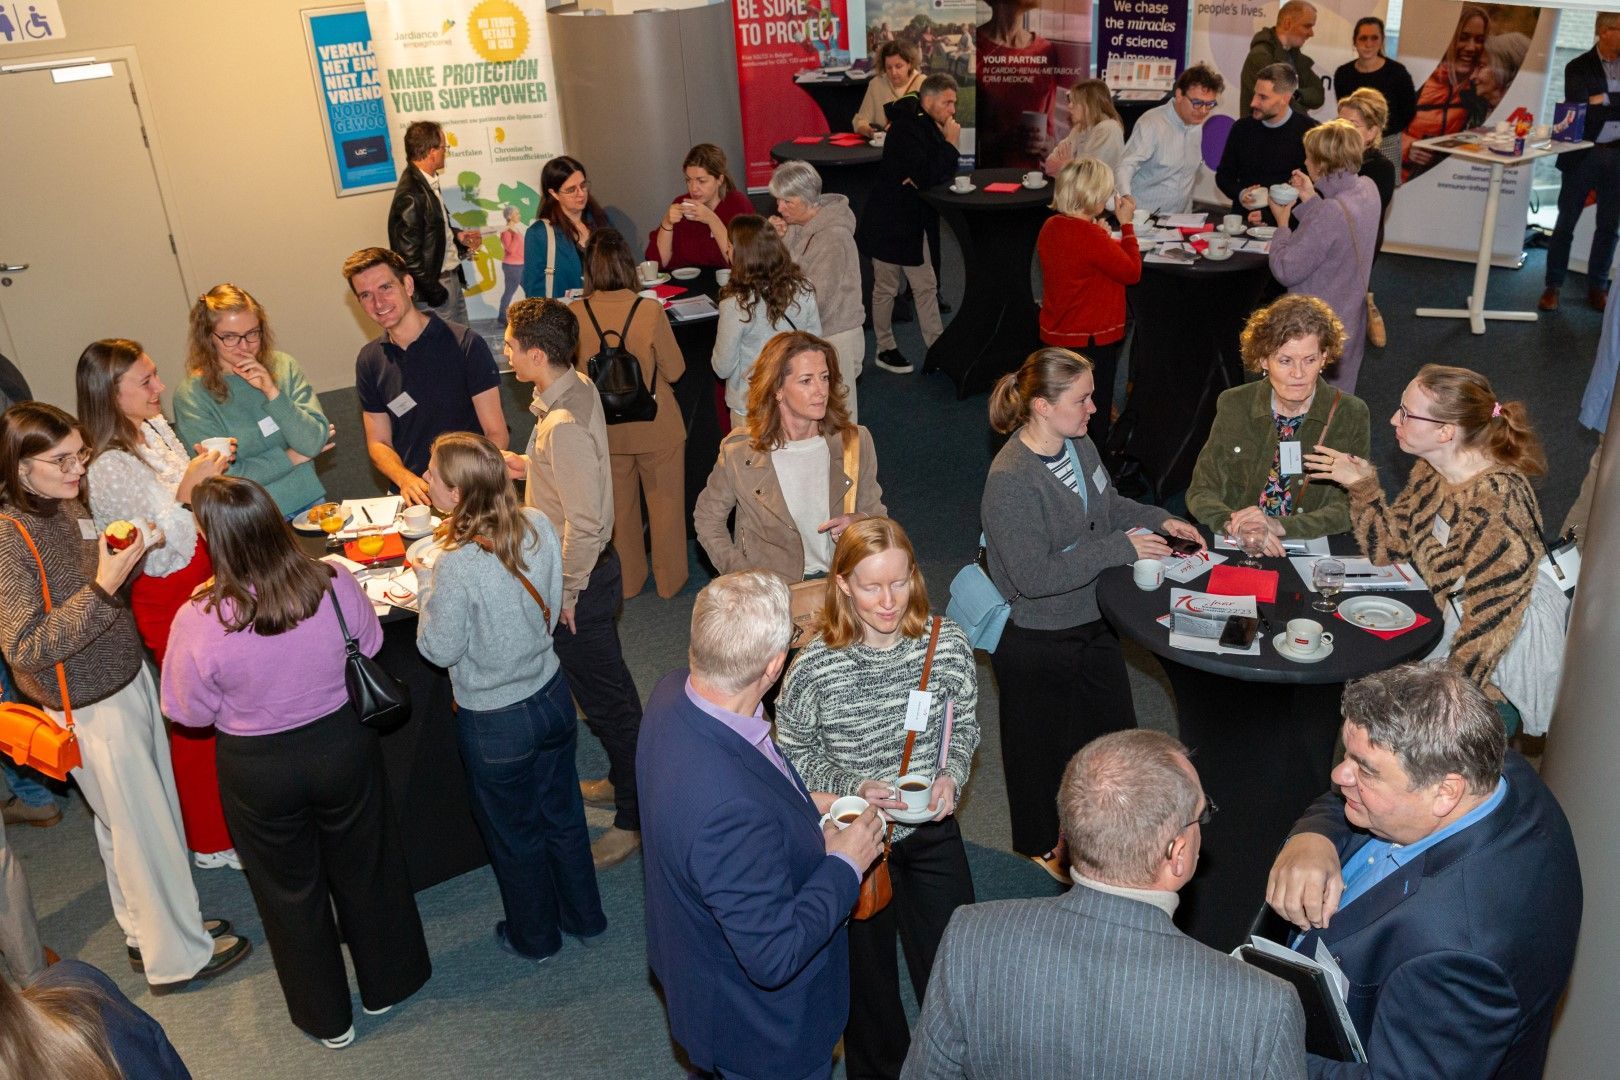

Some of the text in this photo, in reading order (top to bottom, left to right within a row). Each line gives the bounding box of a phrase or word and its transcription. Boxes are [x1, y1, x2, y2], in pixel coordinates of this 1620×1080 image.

[738, 0, 807, 19] BE SURE
[1114, 0, 1168, 14] We chase
[1198, 4, 1266, 17] people's lives.
[739, 17, 839, 46] TO PROTECT
[1105, 17, 1176, 32] the miracles
[394, 31, 439, 40] Jardiance
[1111, 34, 1168, 49] of science
[322, 58, 349, 75] HET
[983, 55, 1047, 64] YOUR PARTNER
[325, 73, 357, 90] NIET
[387, 59, 538, 90] MAKE PROTECTION
[391, 82, 547, 113] YOUR SUPERPOWER
[494, 145, 533, 154] Chronische
